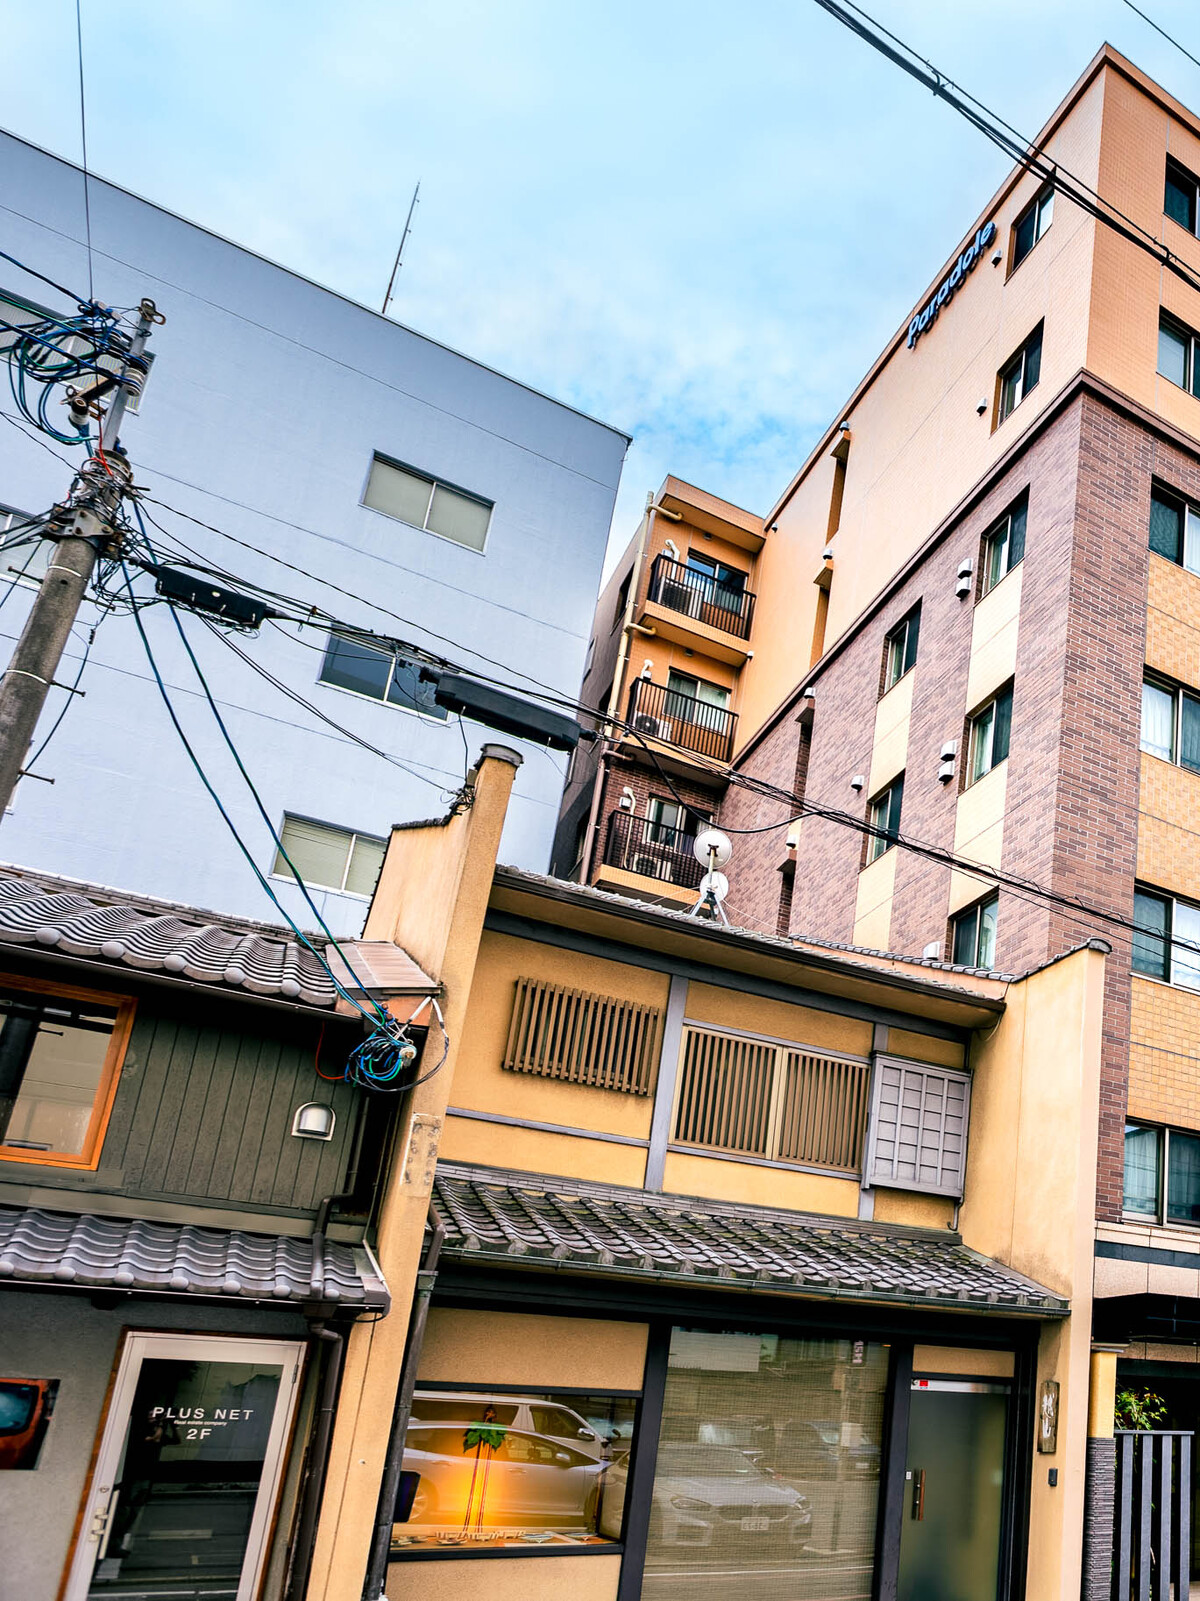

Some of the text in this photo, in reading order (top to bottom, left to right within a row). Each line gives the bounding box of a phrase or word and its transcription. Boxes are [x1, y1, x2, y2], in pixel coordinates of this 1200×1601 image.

[906, 221, 996, 350] Paradole
[152, 1407, 254, 1420] PLUS NET
[186, 1428, 212, 1440] 2F
